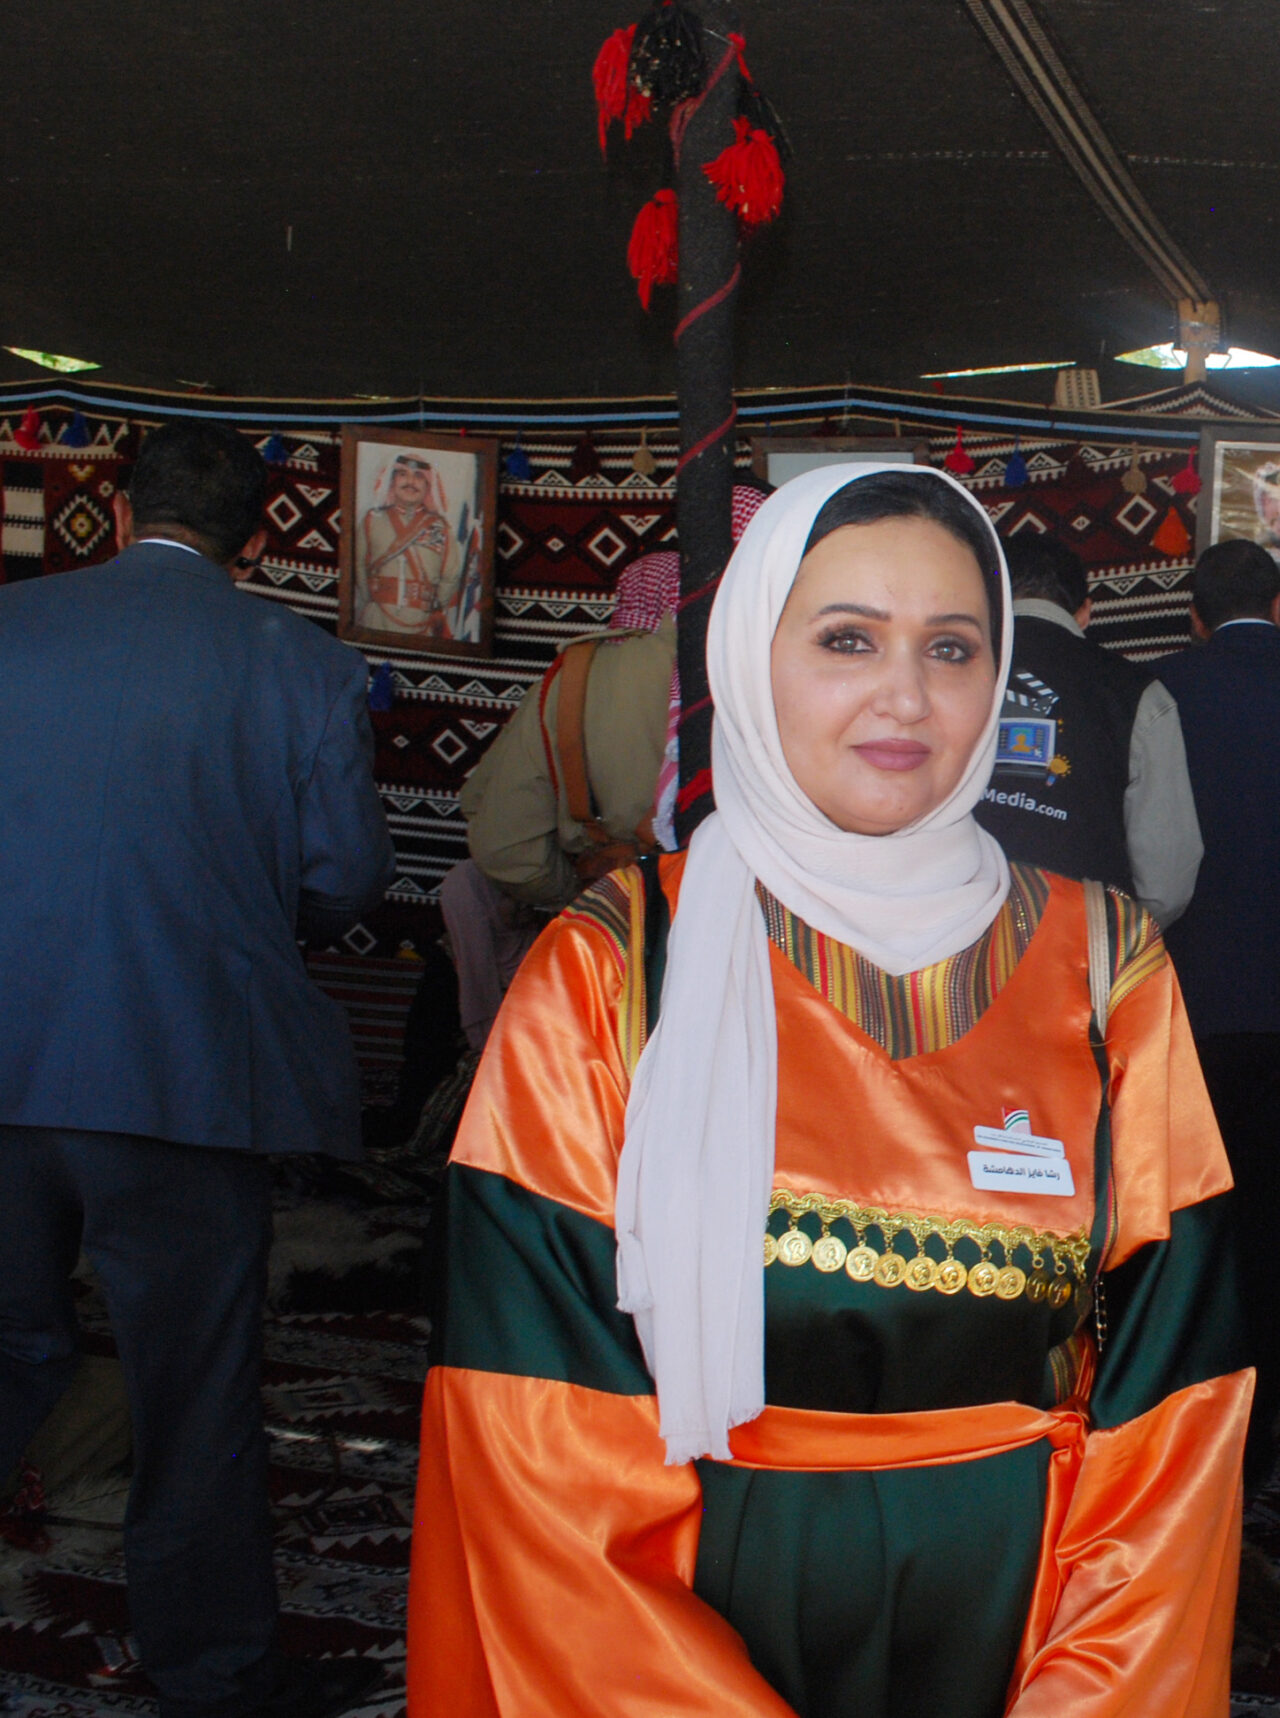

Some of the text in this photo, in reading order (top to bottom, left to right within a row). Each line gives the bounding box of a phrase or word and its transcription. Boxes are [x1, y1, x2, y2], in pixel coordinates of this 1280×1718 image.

[983, 1163, 1060, 1180] رشا فايز الدهامشة
